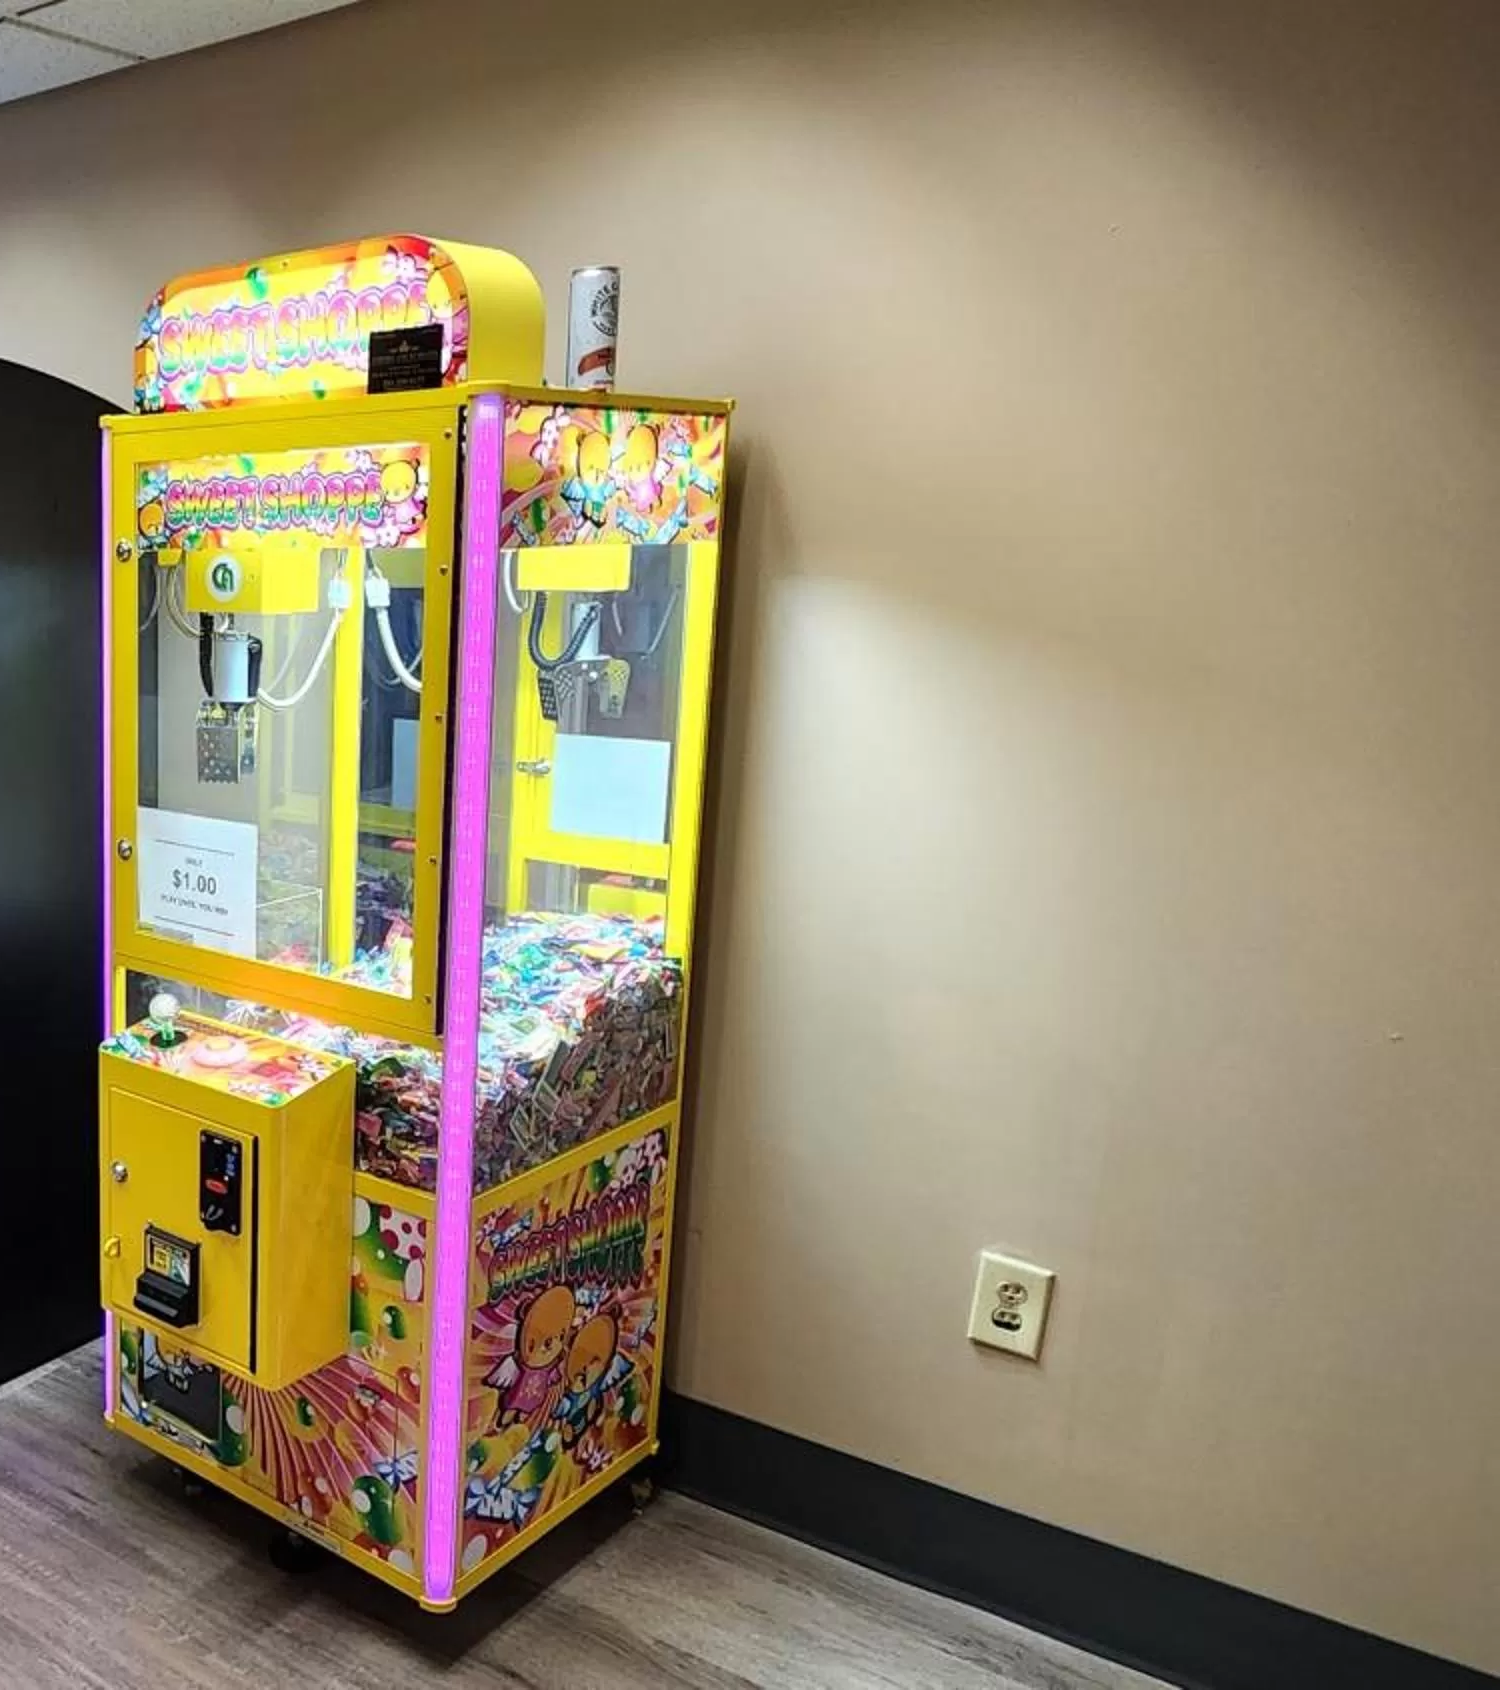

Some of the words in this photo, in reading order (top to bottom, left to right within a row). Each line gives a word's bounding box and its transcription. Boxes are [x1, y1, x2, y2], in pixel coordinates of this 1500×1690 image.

[159, 302, 273, 381] SWEET
[165, 475, 258, 530] SWEET
[259, 470, 386, 528] SHOPPE
[172, 868, 217, 896] $1.00
